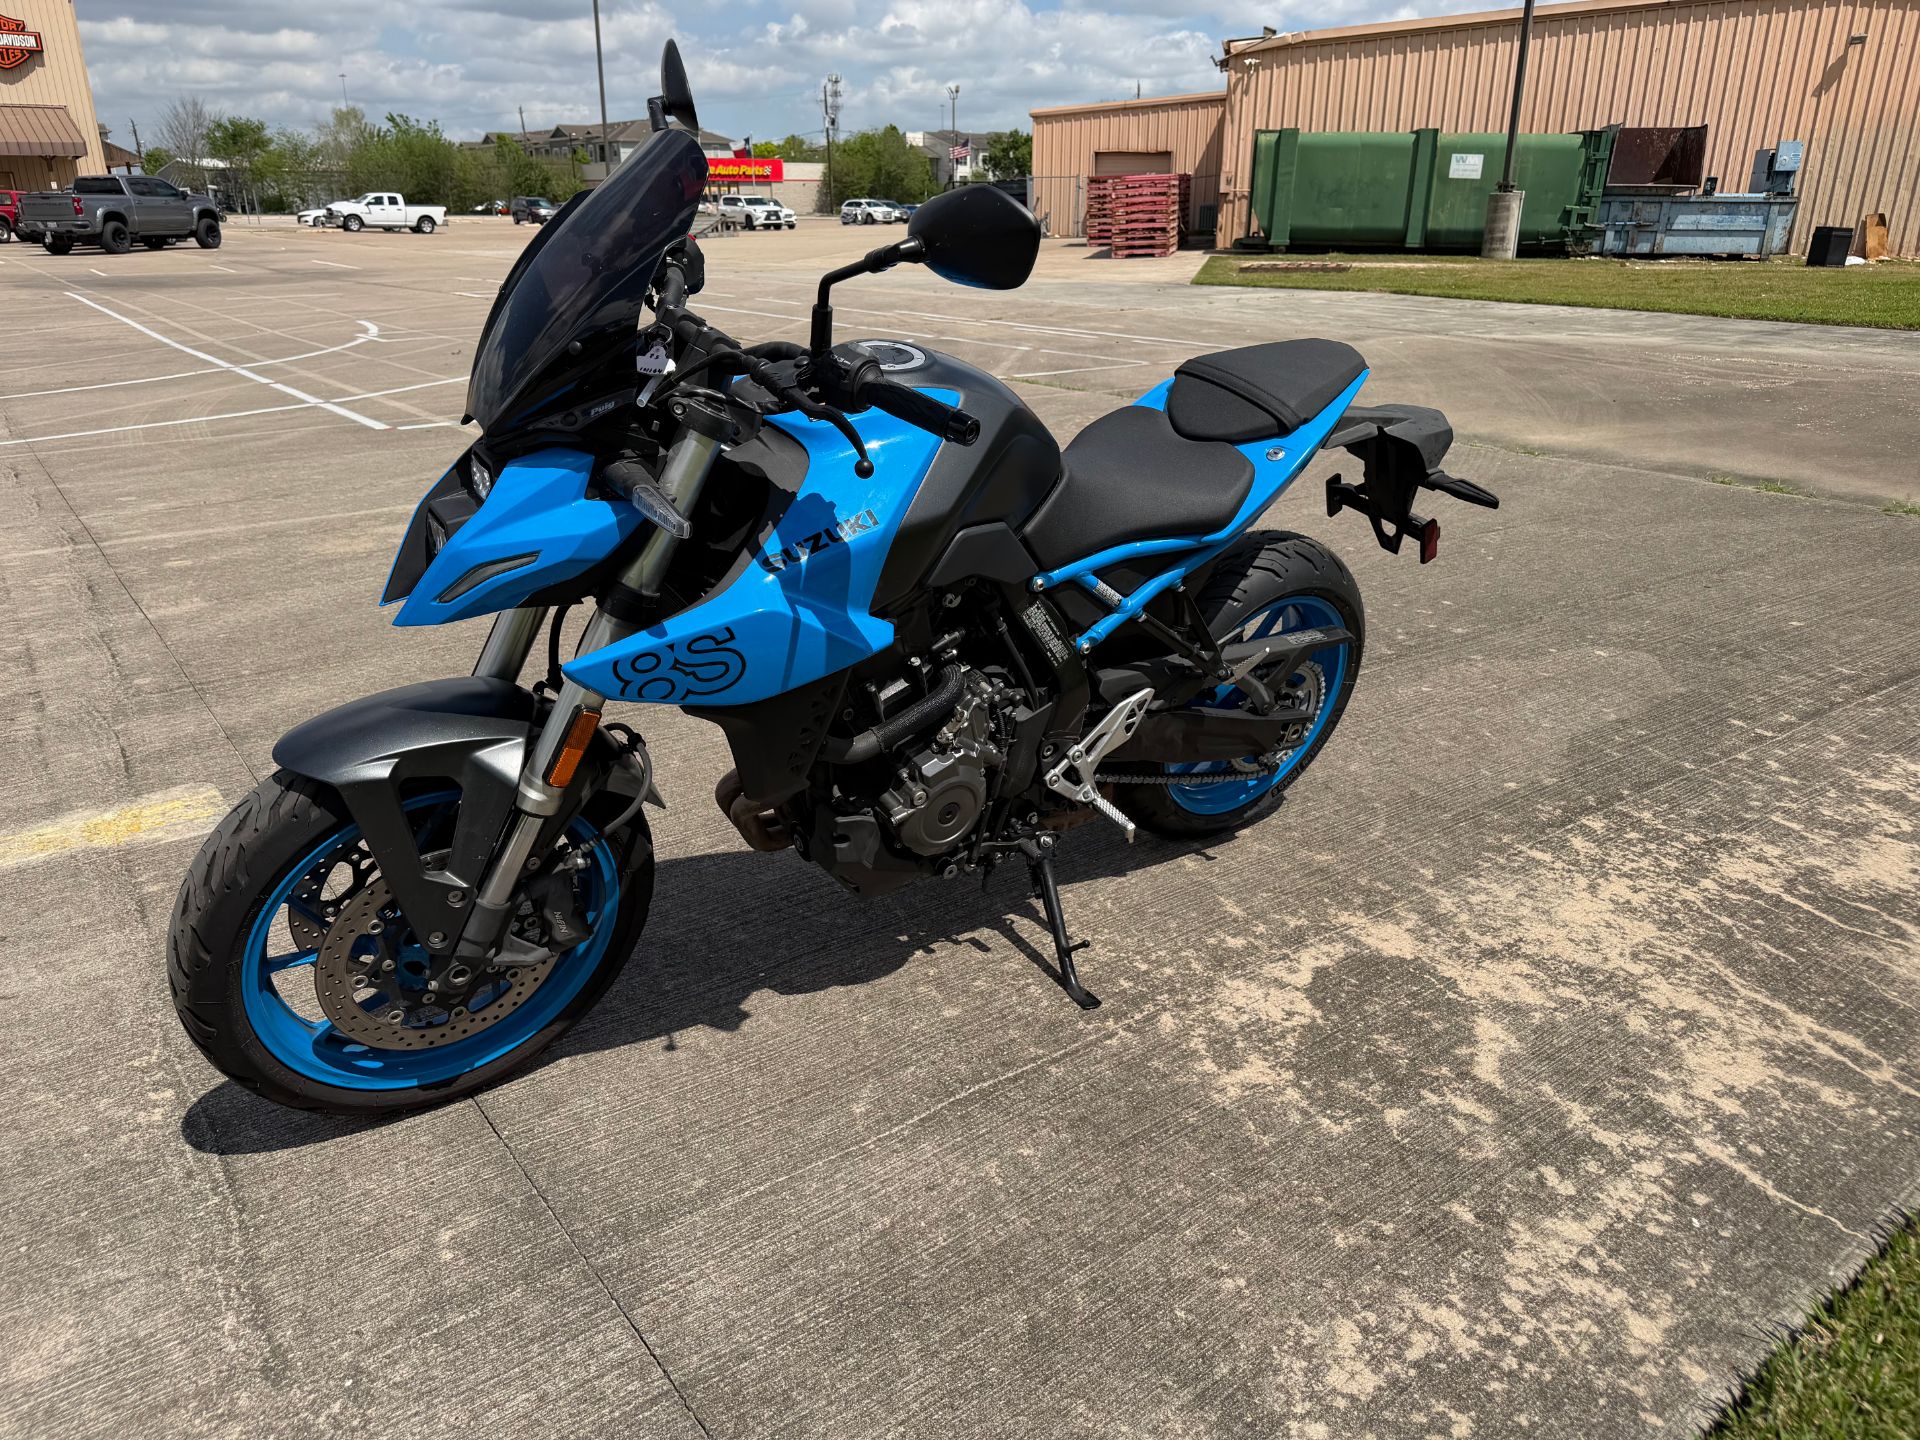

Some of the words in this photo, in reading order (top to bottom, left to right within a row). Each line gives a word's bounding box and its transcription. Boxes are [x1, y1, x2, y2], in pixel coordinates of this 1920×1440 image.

[717, 165, 739, 175] Auto
[740, 165, 764, 175] Parts
[762, 508, 879, 573] SUZUKI
